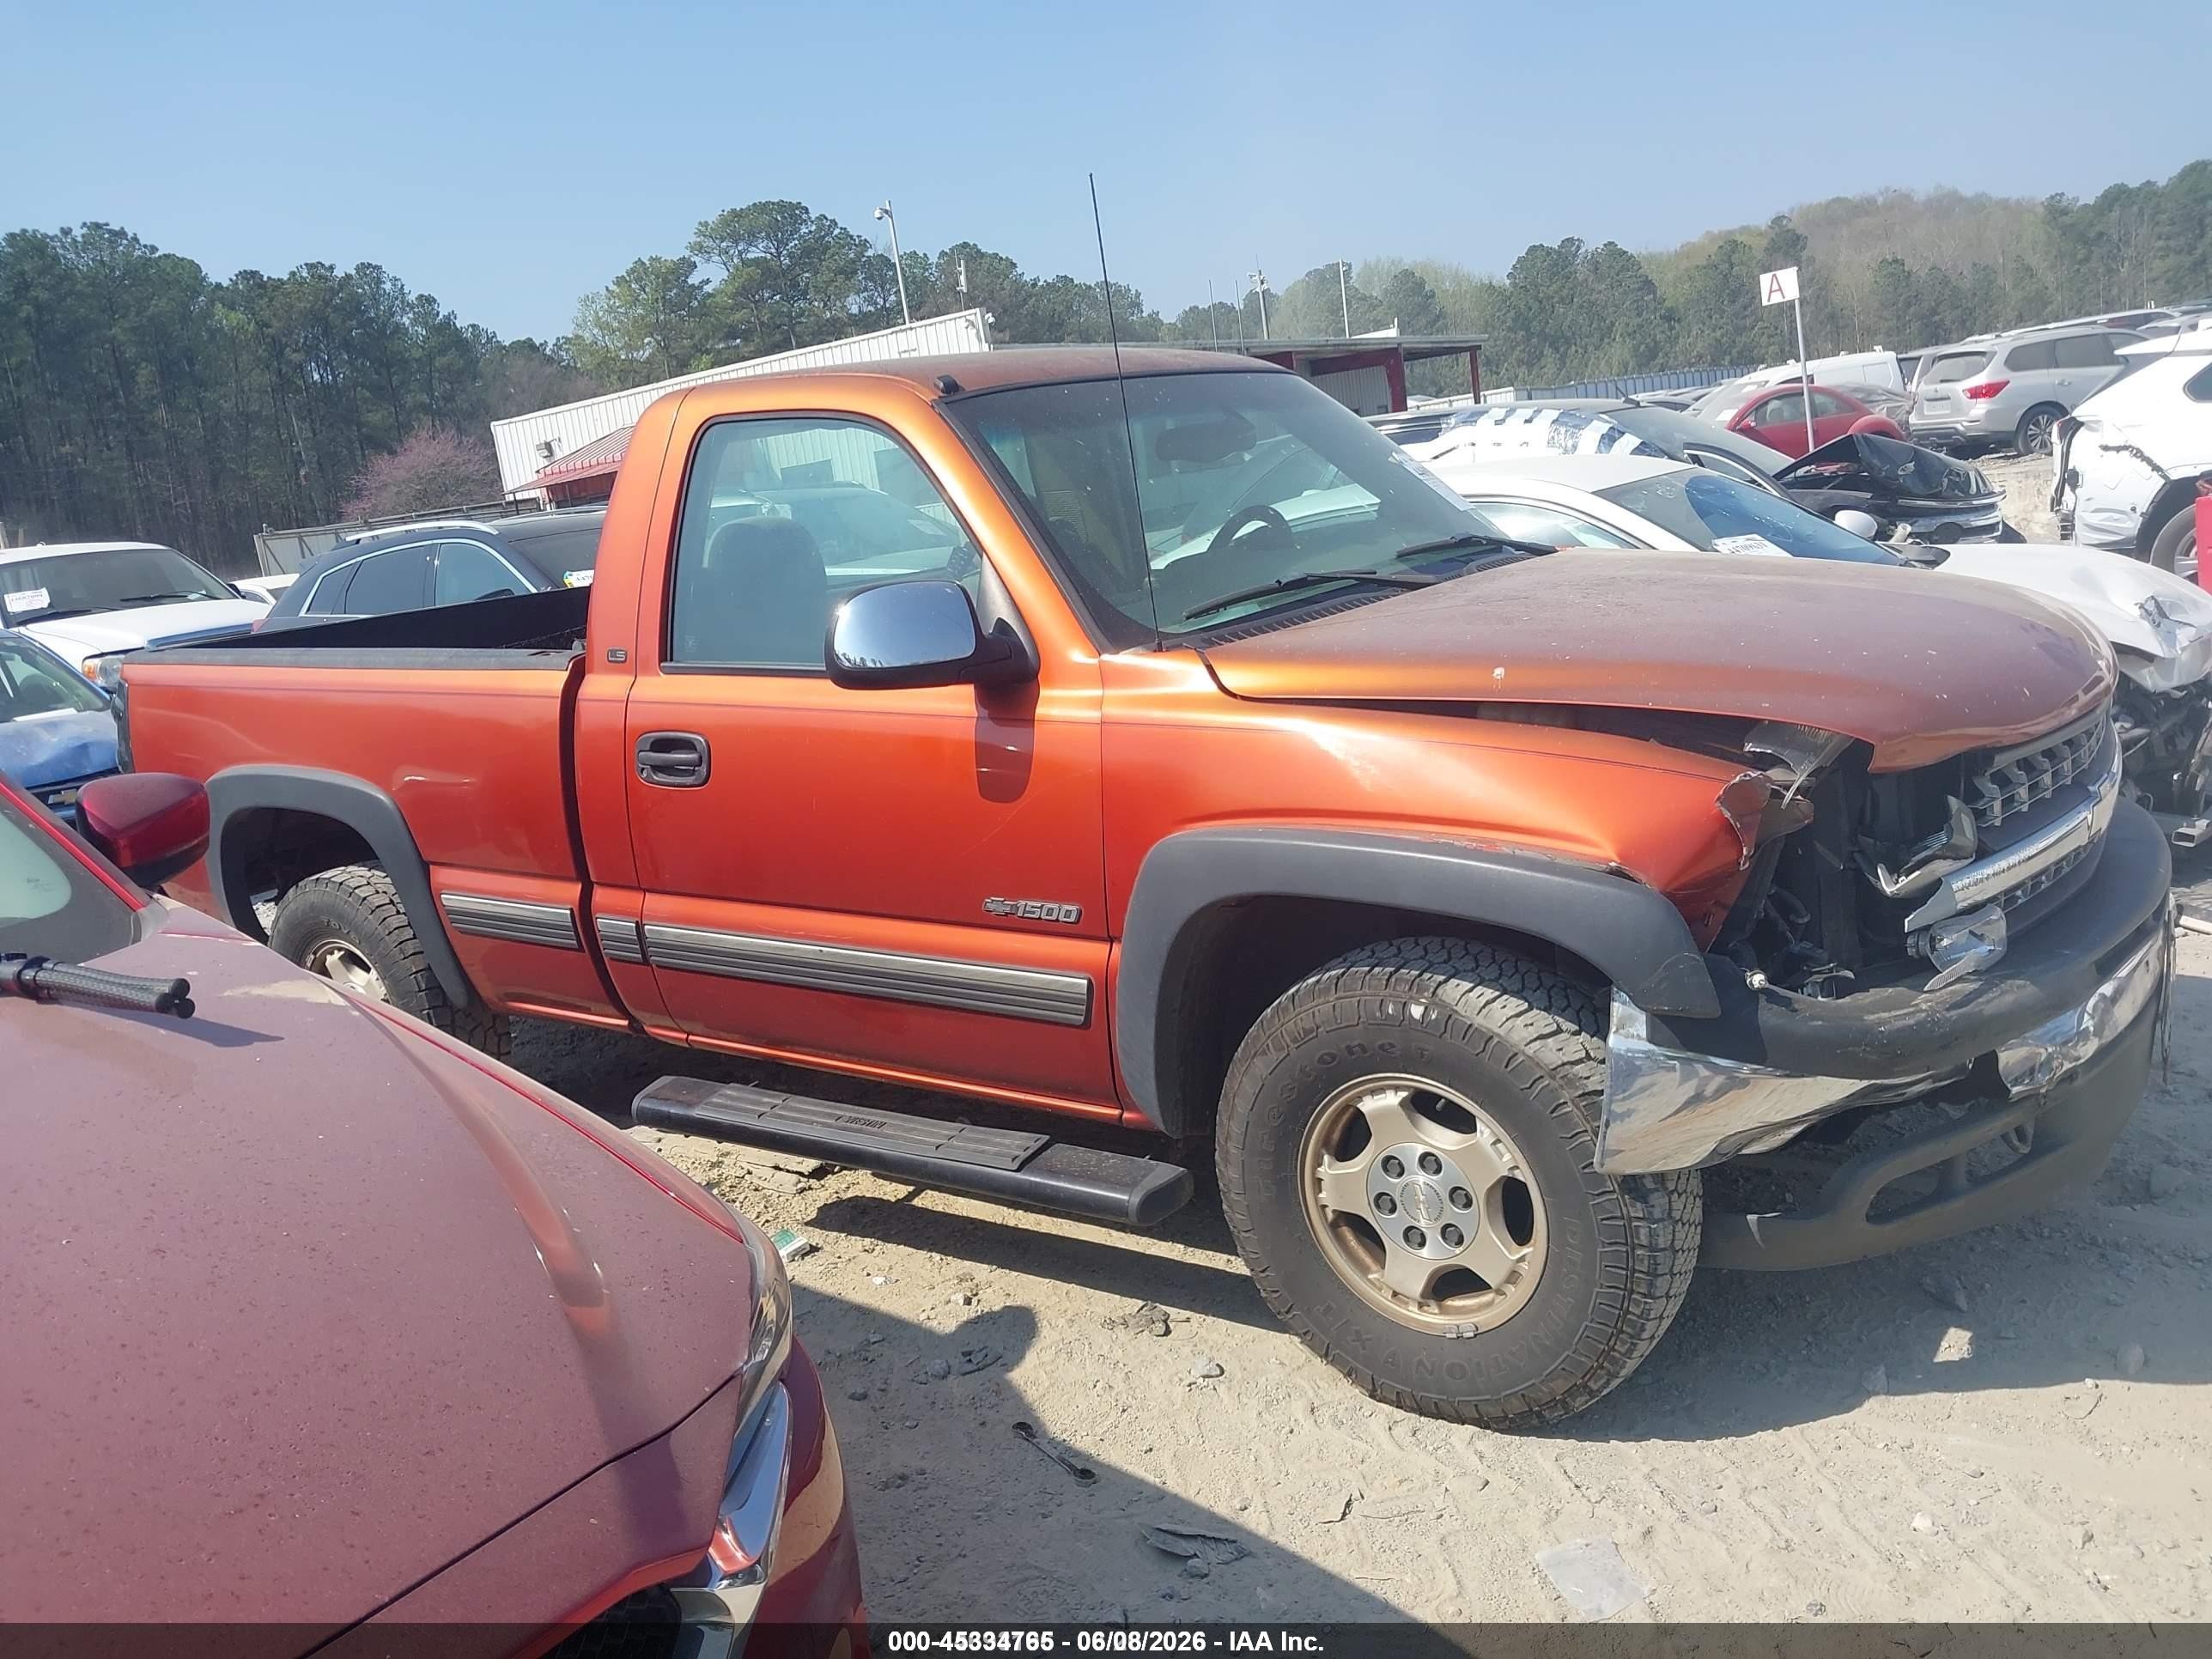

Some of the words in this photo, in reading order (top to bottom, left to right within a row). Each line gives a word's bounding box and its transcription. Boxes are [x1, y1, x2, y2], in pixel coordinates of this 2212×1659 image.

[1767, 273, 1785, 302] A
[608, 650, 626, 661] LS
[1017, 901, 1079, 923] 1500
